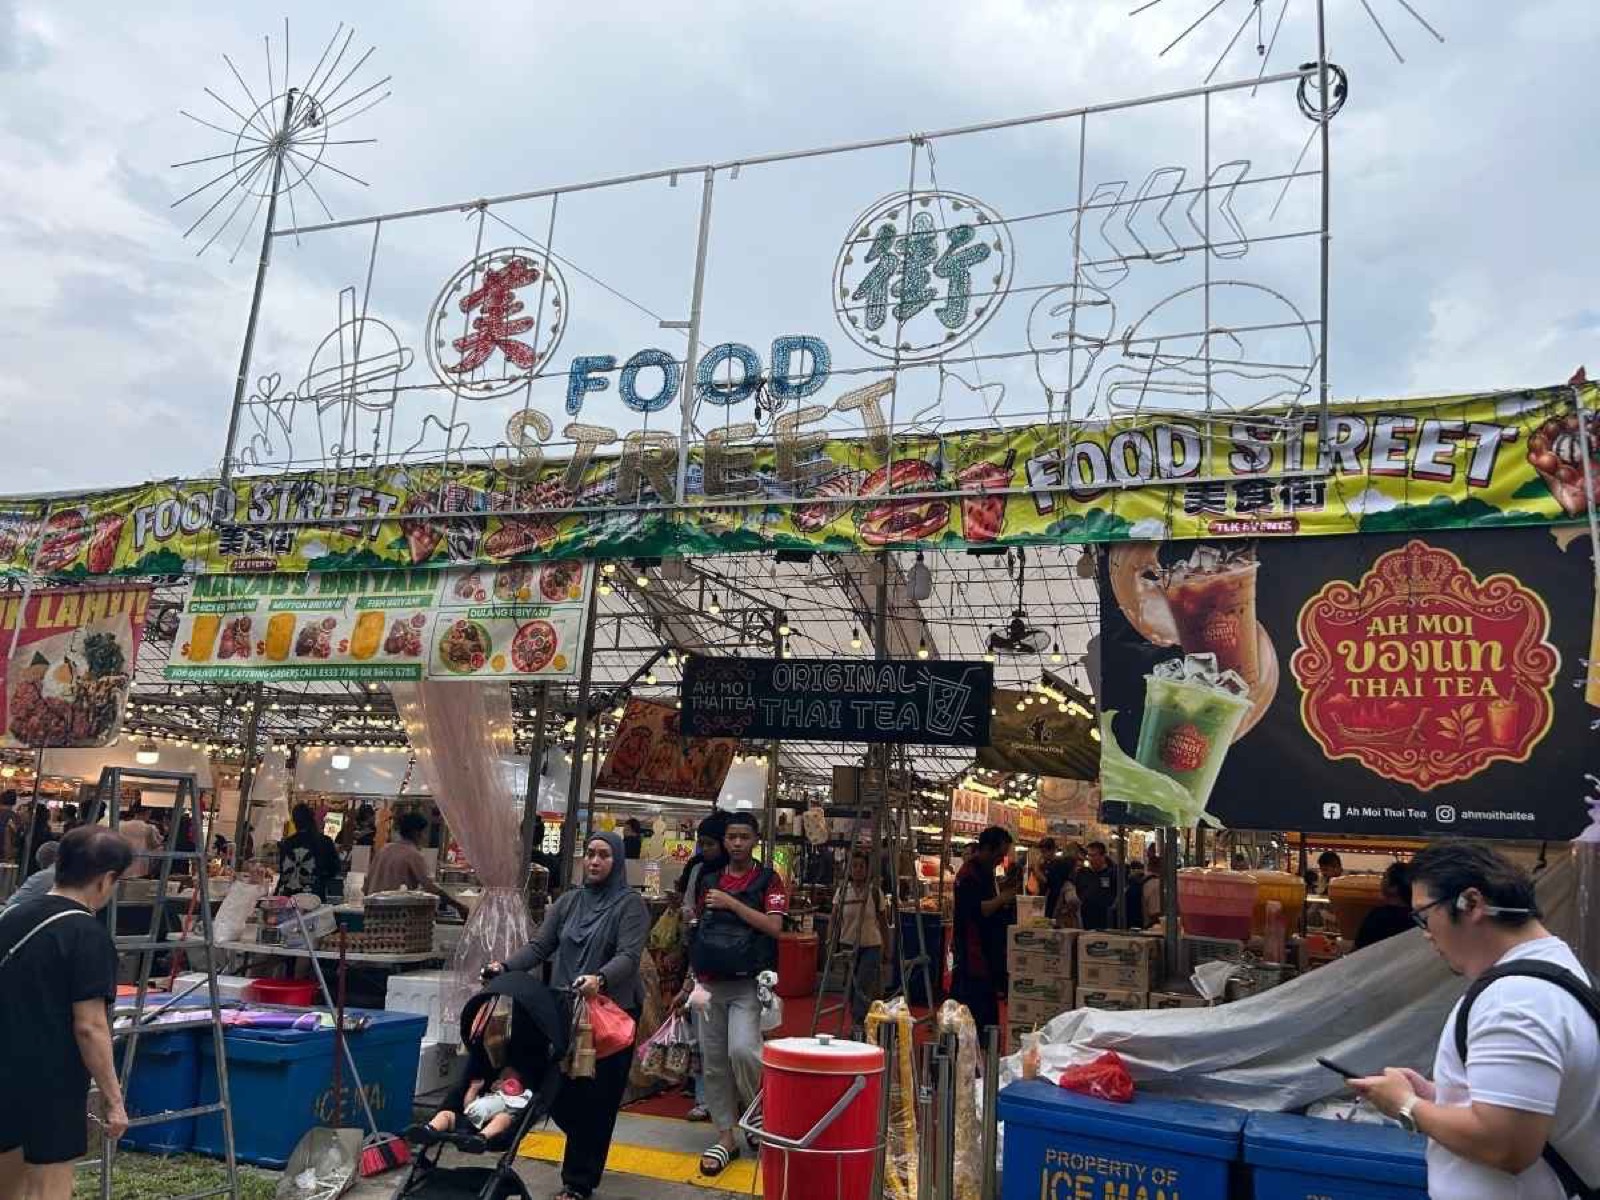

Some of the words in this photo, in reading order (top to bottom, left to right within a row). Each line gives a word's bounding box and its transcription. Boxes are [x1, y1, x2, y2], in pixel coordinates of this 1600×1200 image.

[851, 211, 991, 332] 街
[448, 258, 540, 373] 美
[565, 333, 833, 416] FOOD
[499, 377, 896, 503] STREET
[1025, 424, 1204, 516] FOOD
[1228, 413, 1518, 488] STREET
[132, 486, 237, 552] FOOD
[248, 479, 401, 542] STREET
[1366, 614, 1409, 637] AH
[1416, 614, 1473, 636] MOI
[692, 681, 716, 696] AH
[772, 662, 917, 694] ORIGINAL
[1345, 677, 1424, 698] THAI
[1433, 676, 1500, 697] TEA
[758, 698, 843, 729] THAI
[850, 700, 920, 731] TEA
[1346, 806, 1360, 817] Ah
[1362, 807, 1381, 817] Moi
[1384, 808, 1405, 818] Thai
[1407, 808, 1428, 819] Tea
[1460, 809, 1535, 821] ahmoithaitea
[1045, 1148, 1146, 1181] PROPERTY
[1151, 1167, 1180, 1187] OF
